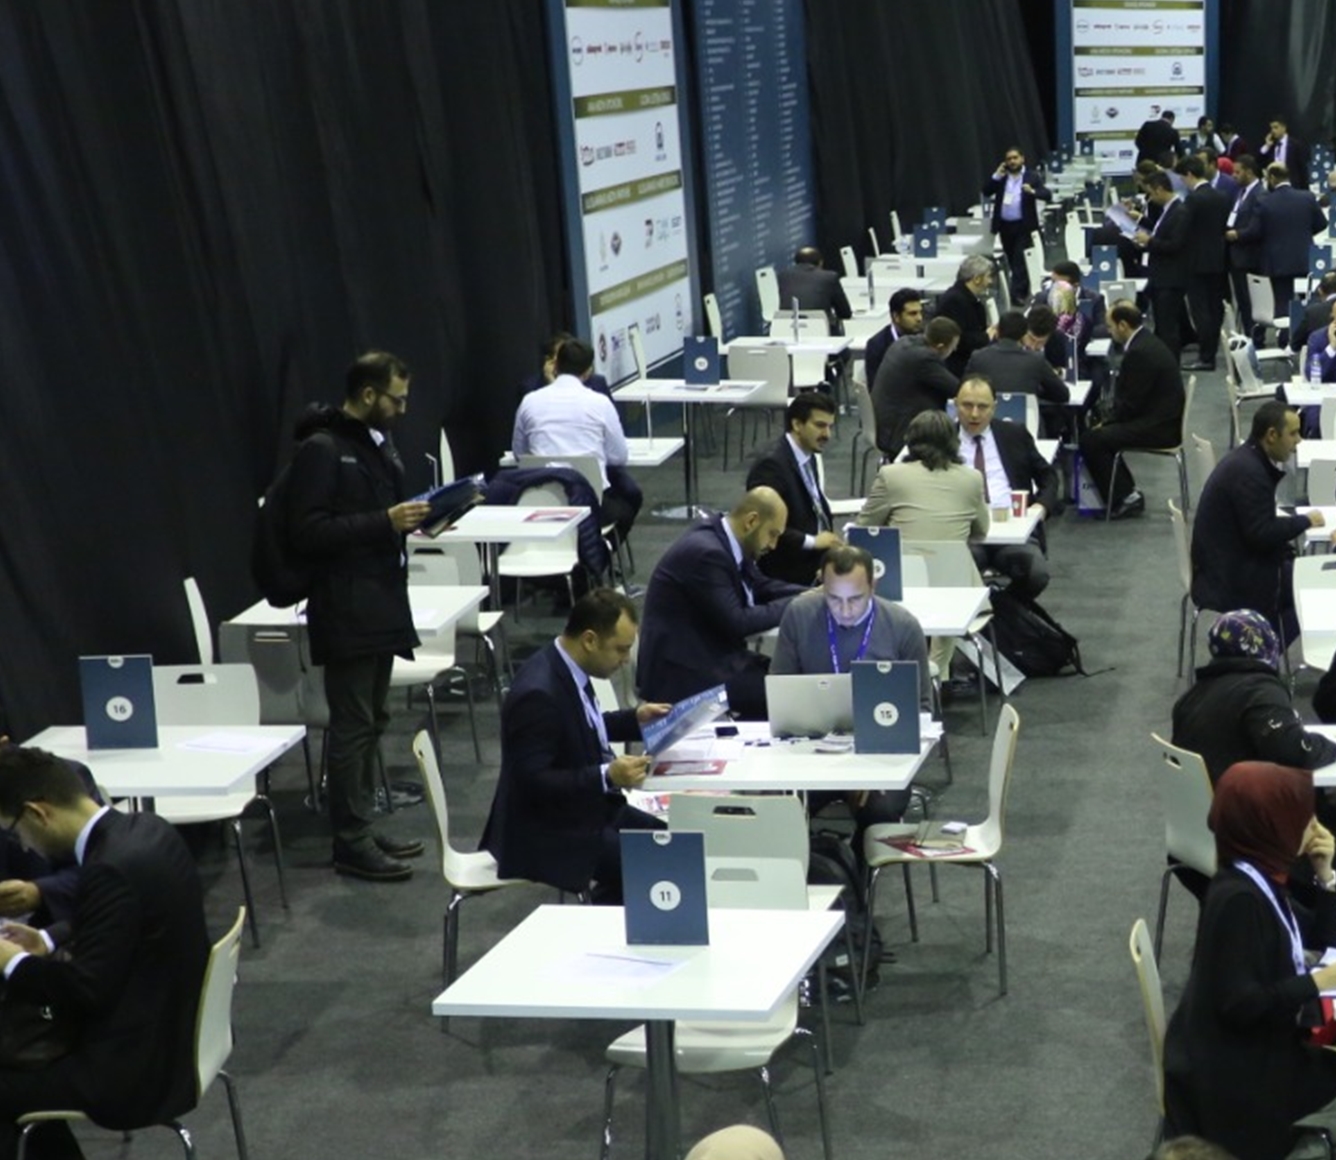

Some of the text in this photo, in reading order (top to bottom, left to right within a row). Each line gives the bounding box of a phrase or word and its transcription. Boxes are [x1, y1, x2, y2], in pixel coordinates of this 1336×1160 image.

[113, 704, 127, 715] 16
[879, 710, 893, 719] 15
[659, 891, 672, 902] 11
